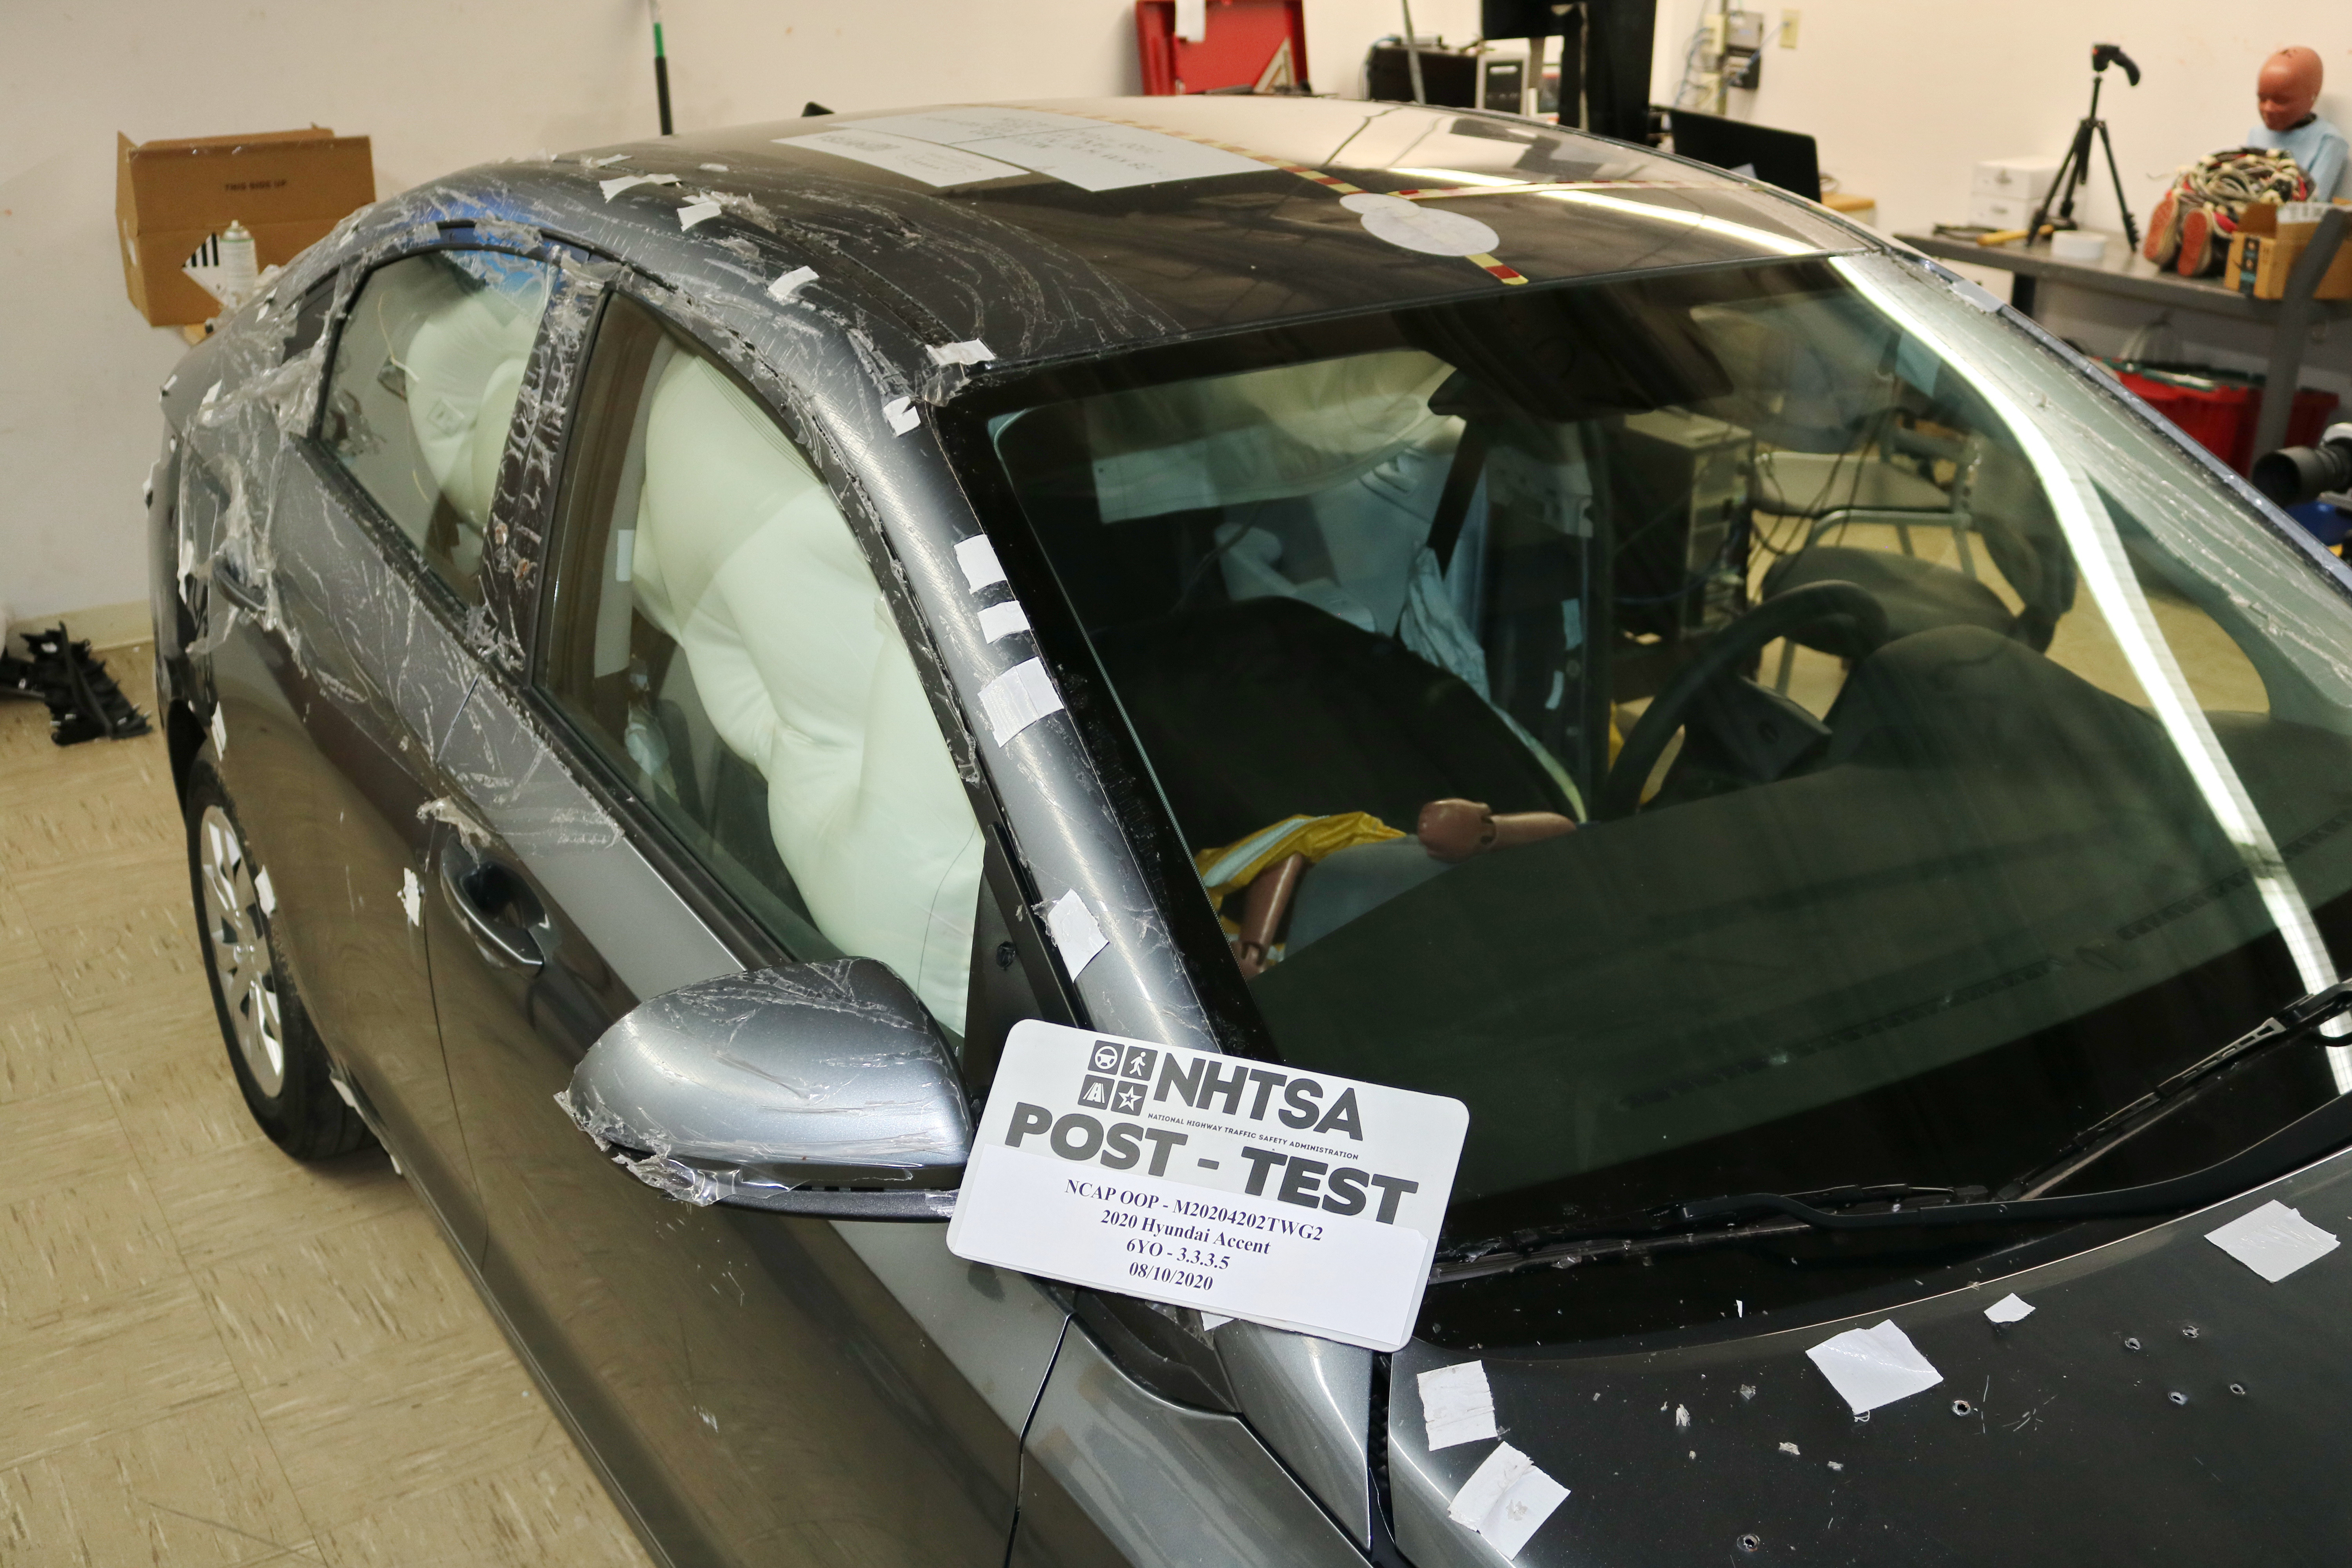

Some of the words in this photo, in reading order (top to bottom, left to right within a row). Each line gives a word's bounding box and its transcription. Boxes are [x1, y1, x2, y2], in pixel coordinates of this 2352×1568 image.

[1154, 1053, 1363, 1141] NHTSA
[1148, 1113, 1184, 1125] NATIONAL
[1187, 1120, 1223, 1132] HIGHWAY
[1225, 1127, 1256, 1138] TRAFFIC
[1259, 1134, 1288, 1145] SAFETY
[1289, 1141, 1359, 1160] ADMINISTRATION
[1005, 1102, 1188, 1176] POST
[1198, 1158, 1219, 1170] -
[1241, 1146, 1419, 1225] TEST
[1065, 1179, 1116, 1201] NCAP
[1120, 1190, 1159, 1209] OOP
[1172, 1199, 1323, 1241] M20204202TWG2
[1100, 1210, 1138, 1228] 2020
[1142, 1217, 1210, 1242] Hyundai
[1213, 1231, 1271, 1254] Accent
[1126, 1238, 1163, 1257] 6YO
[1176, 1247, 1230, 1270] 3.3.3.5
[1129, 1261, 1214, 1290] 08/10/2020
